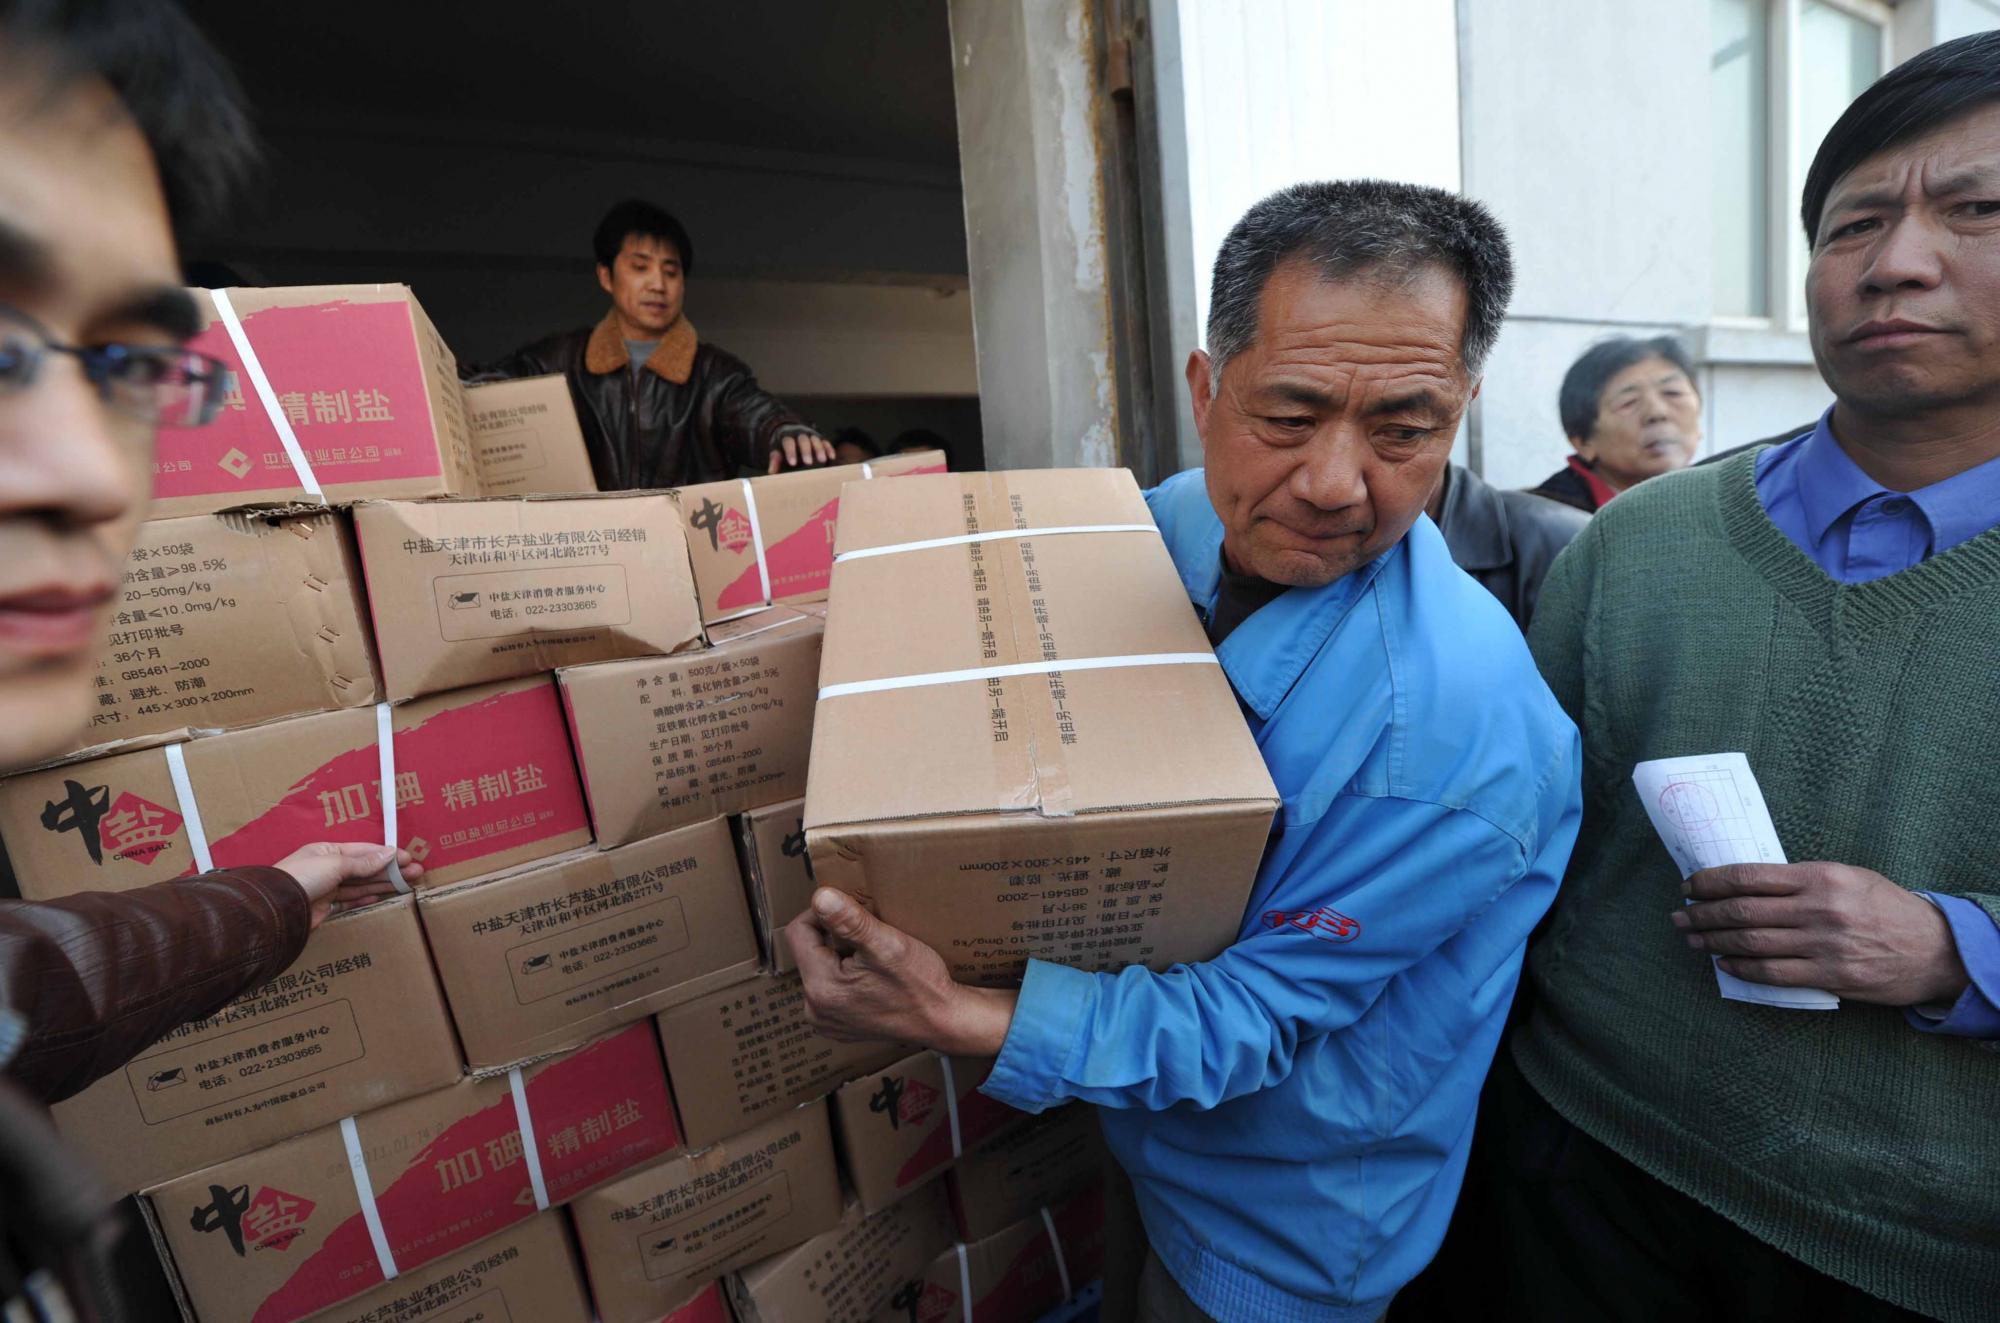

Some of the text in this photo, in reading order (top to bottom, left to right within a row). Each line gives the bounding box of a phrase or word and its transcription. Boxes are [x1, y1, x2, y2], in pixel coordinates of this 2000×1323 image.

[279, 388, 394, 426] 精制盐
[402, 528, 647, 554] 中盐天津市长芦盐业有限公司经销
[449, 545, 611, 567] 天津市和平区河北路277号
[110, 597, 237, 626] 含量≤10.0mg/kg
[489, 583, 606, 602] 中盐天津消费者服务中心
[977, 598, 998, 659] 请由另一端开启
[441, 763, 547, 812] 精制盐
[40, 780, 167, 867] 中盐
[113, 841, 173, 861] CHINA SALT
[472, 856, 698, 936] 中盐天津市长芦盐业有限公司经销
[520, 882, 663, 937] 天津市和平区河北路277号
[559, 918, 664, 960] 中盐天津消费者服务中心
[194, 1025, 331, 1074] 中盐天津消费者服务中心
[204, 1081, 327, 1127] 商标持有人为中国盐业总公司
[434, 1098, 644, 1194] 加碘 精制盐
